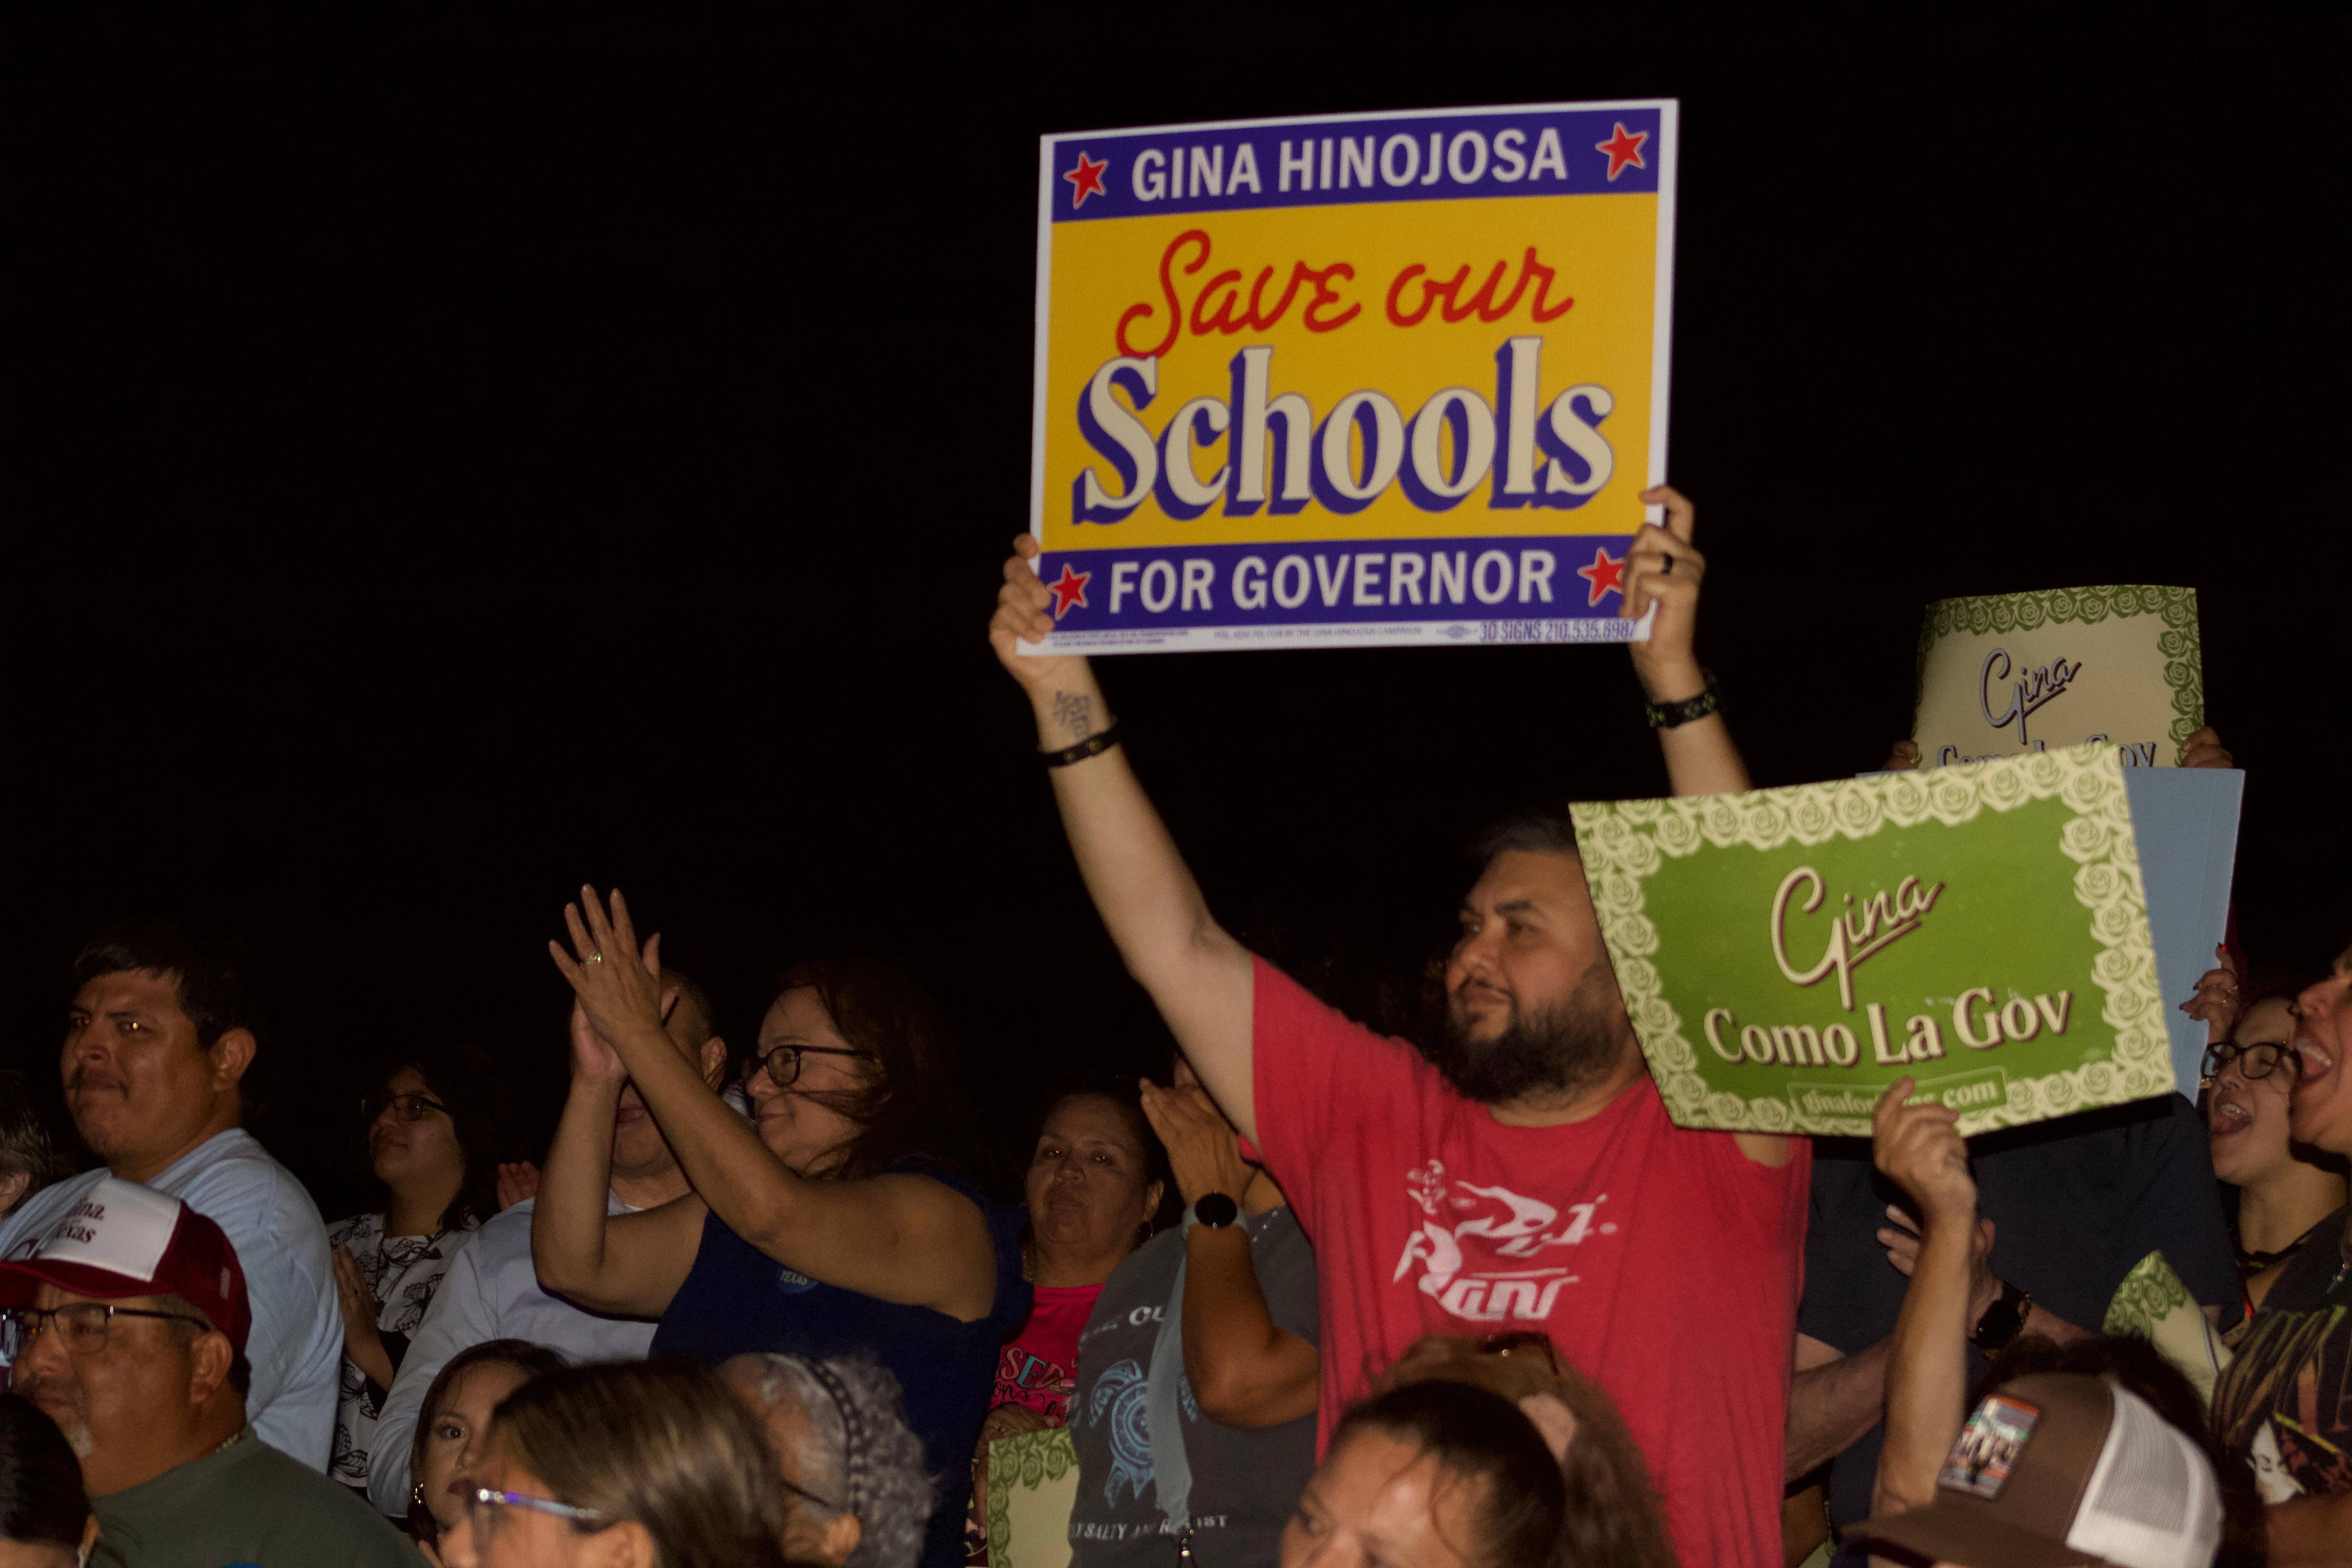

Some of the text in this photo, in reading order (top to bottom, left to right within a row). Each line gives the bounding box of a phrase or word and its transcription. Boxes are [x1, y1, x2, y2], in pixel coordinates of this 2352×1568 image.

[1131, 127, 1568, 202] GINA HINOJOSA
[1114, 229, 1575, 360] Save our
[1071, 336, 1614, 526] Schools
[1109, 550, 1557, 613] FOR GOVERNOR
[1500, 620, 1542, 641] SIGNS
[1980, 648, 2082, 745] Gina
[1770, 865, 1945, 1011] Gina
[1703, 986, 2072, 1068] Como La Gov
